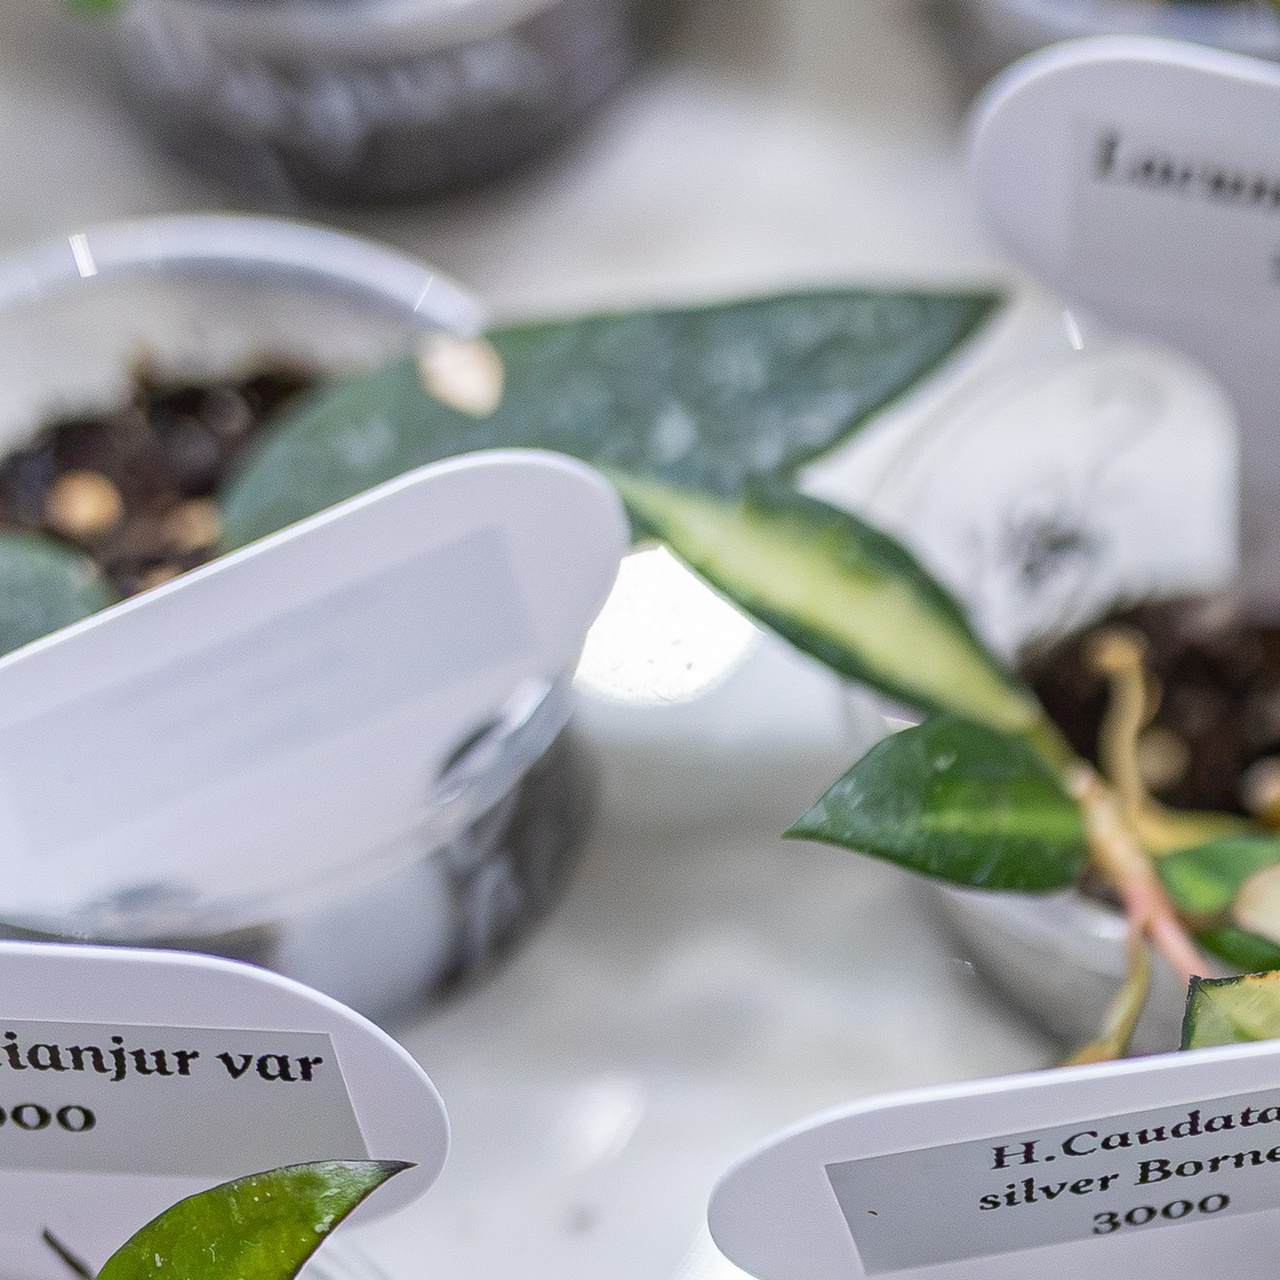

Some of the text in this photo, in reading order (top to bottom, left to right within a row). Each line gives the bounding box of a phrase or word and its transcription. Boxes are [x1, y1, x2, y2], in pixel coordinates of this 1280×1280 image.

[0, 1030, 324, 1083] ianjur var
[0, 1103, 97, 1132] 00
[978, 1176, 1120, 1212] silver
[1092, 1192, 1232, 1236] 3000
